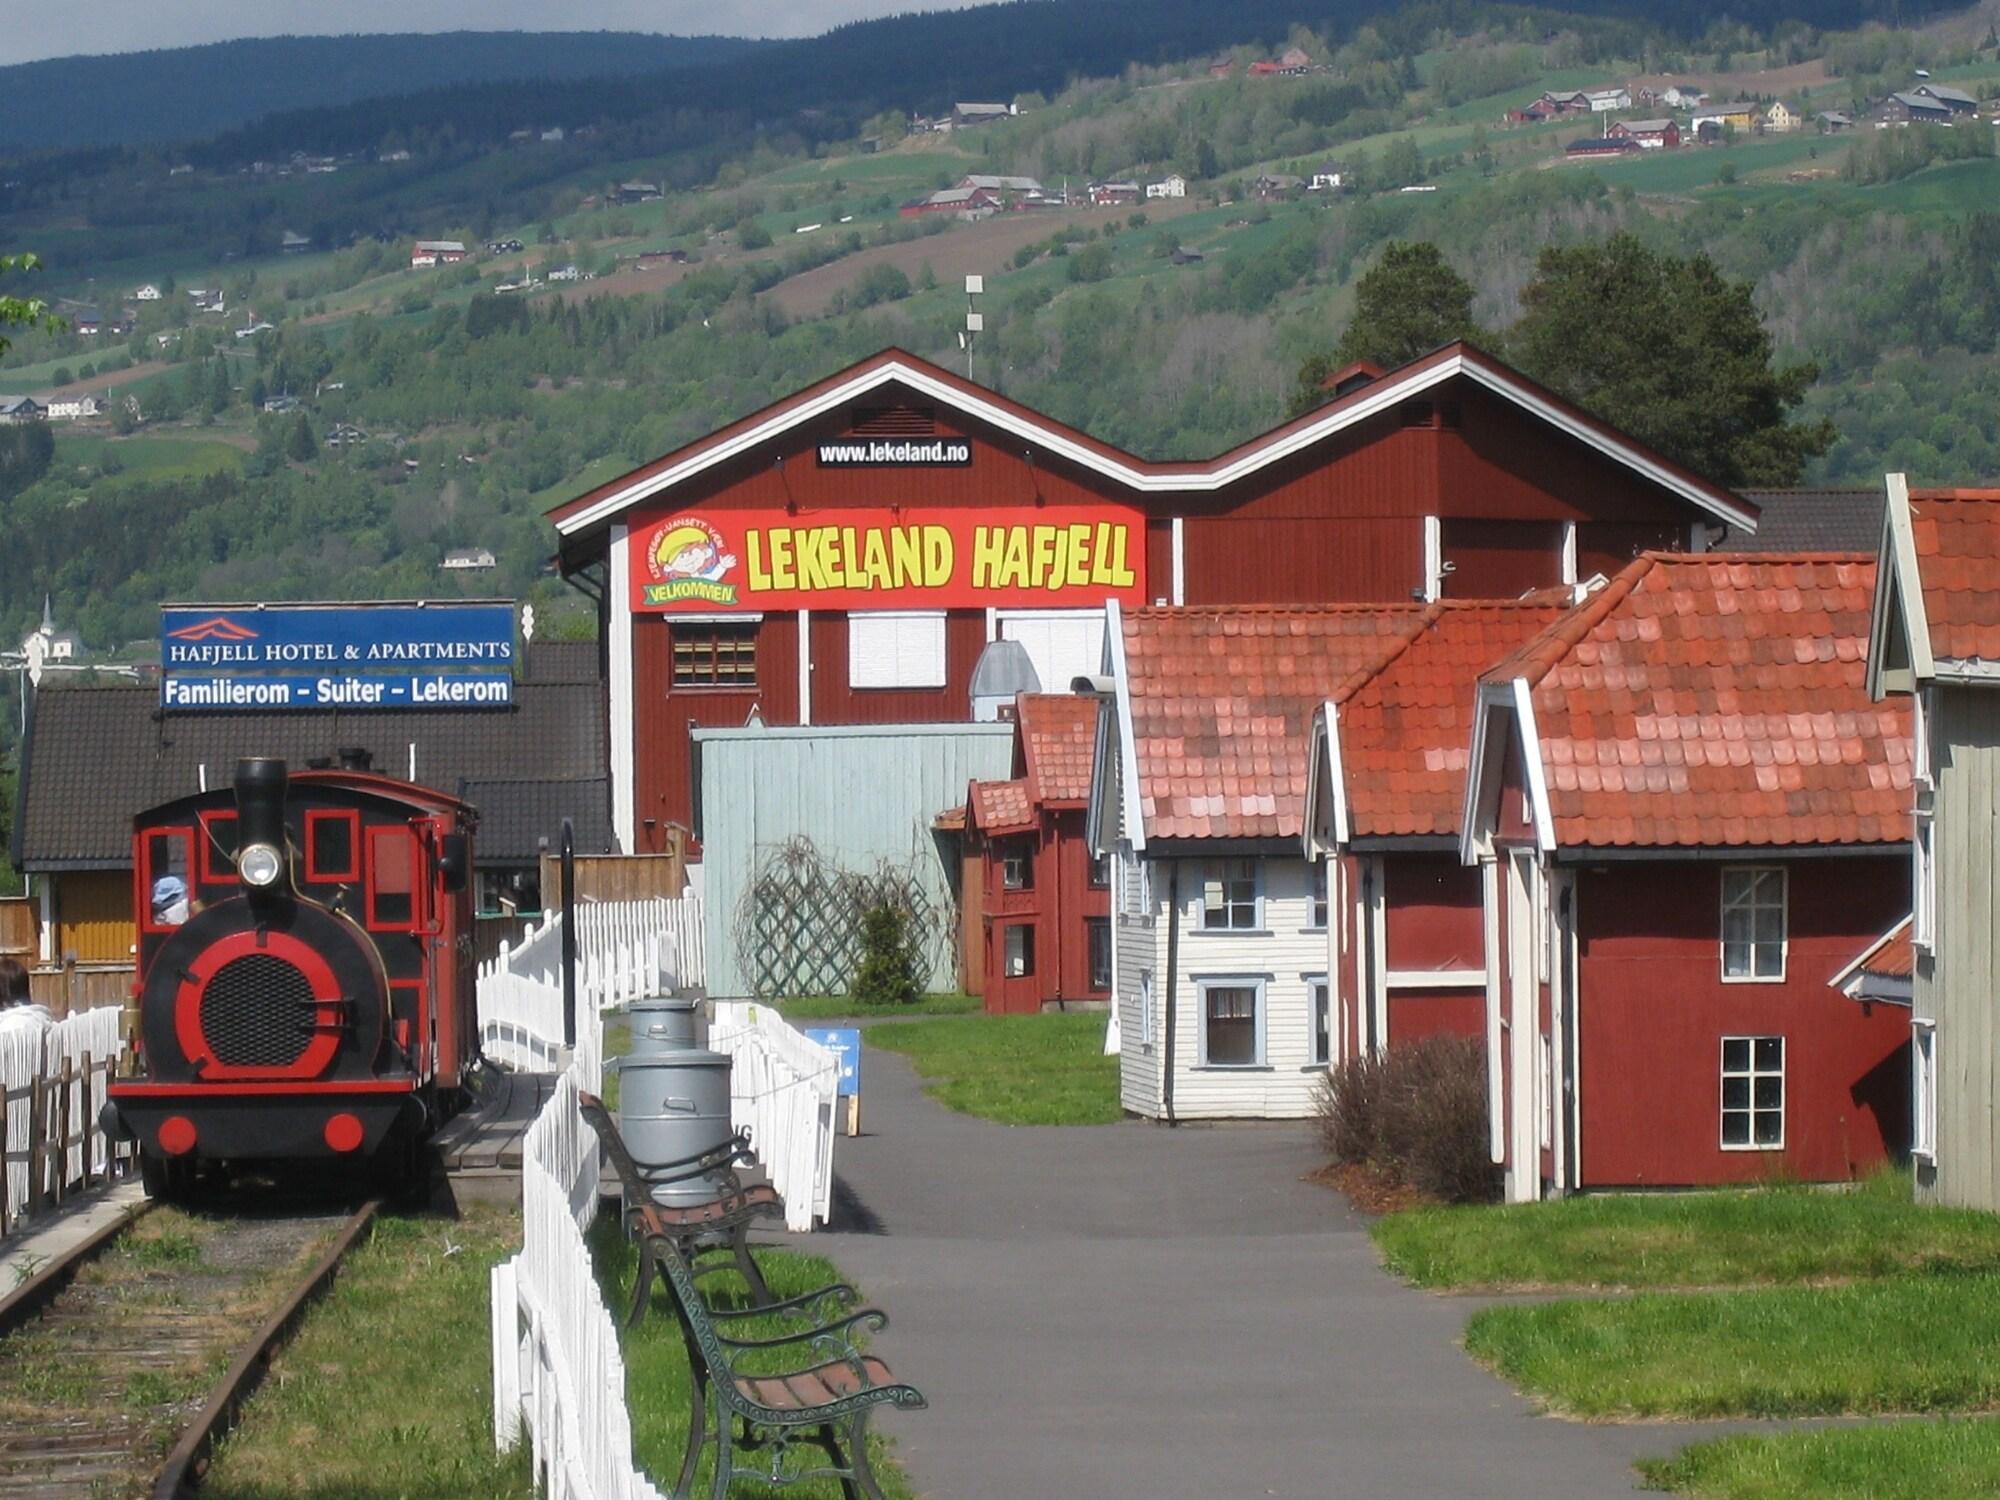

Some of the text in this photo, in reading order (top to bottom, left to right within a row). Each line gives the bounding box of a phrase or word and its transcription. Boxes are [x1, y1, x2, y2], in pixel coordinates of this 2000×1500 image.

[820, 441, 969, 463] www.lekeland.no
[745, 521, 1137, 592] LEKELAND HAFJELL
[649, 581, 733, 602] VELKOMMEN
[170, 641, 511, 666] HAFJELL HOTEL & APARTMENTS
[165, 679, 290, 704] Familierom
[316, 678, 385, 703] Suiter
[411, 677, 508, 702] Lekerom
